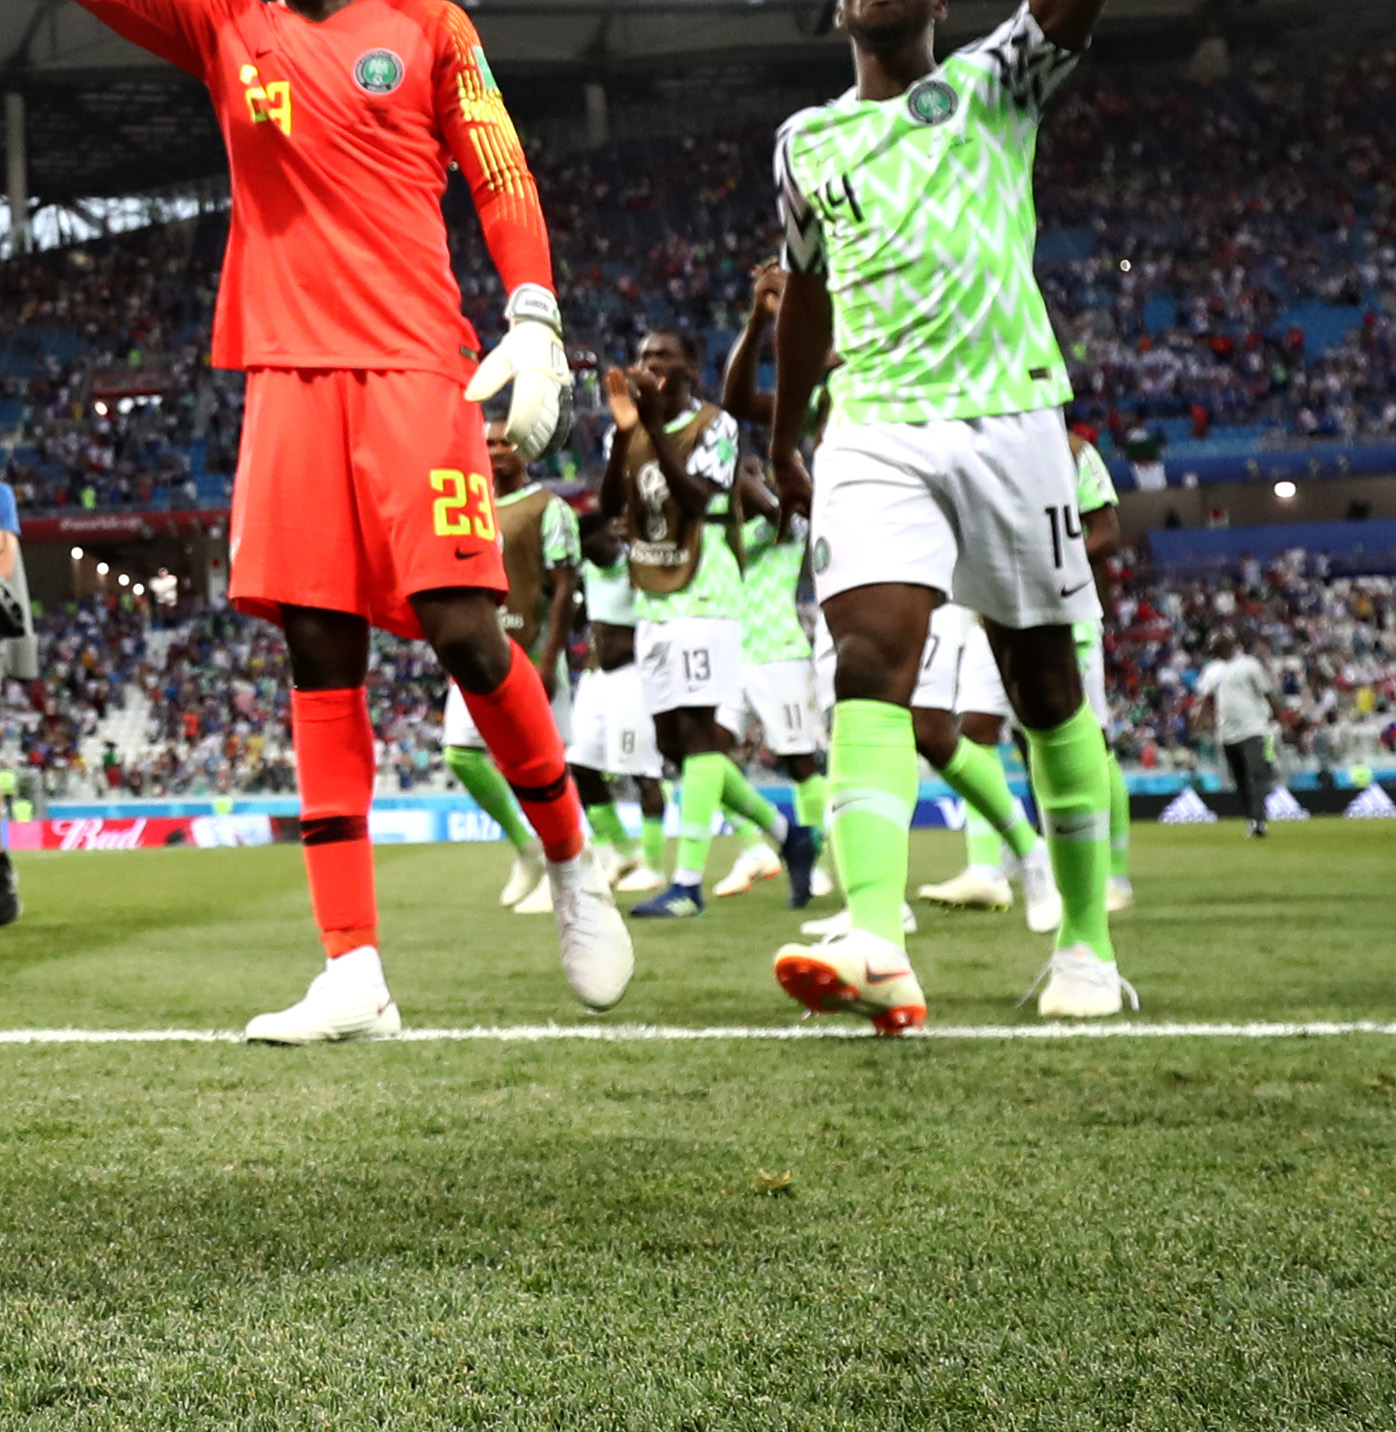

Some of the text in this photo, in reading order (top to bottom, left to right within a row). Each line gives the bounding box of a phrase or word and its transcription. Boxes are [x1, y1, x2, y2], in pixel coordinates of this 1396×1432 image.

[810, 172, 864, 224] 14
[430, 469, 497, 541] 23
[683, 649, 712, 681] 13
[784, 703, 802, 730] 11
[51, 817, 147, 851] Bud
